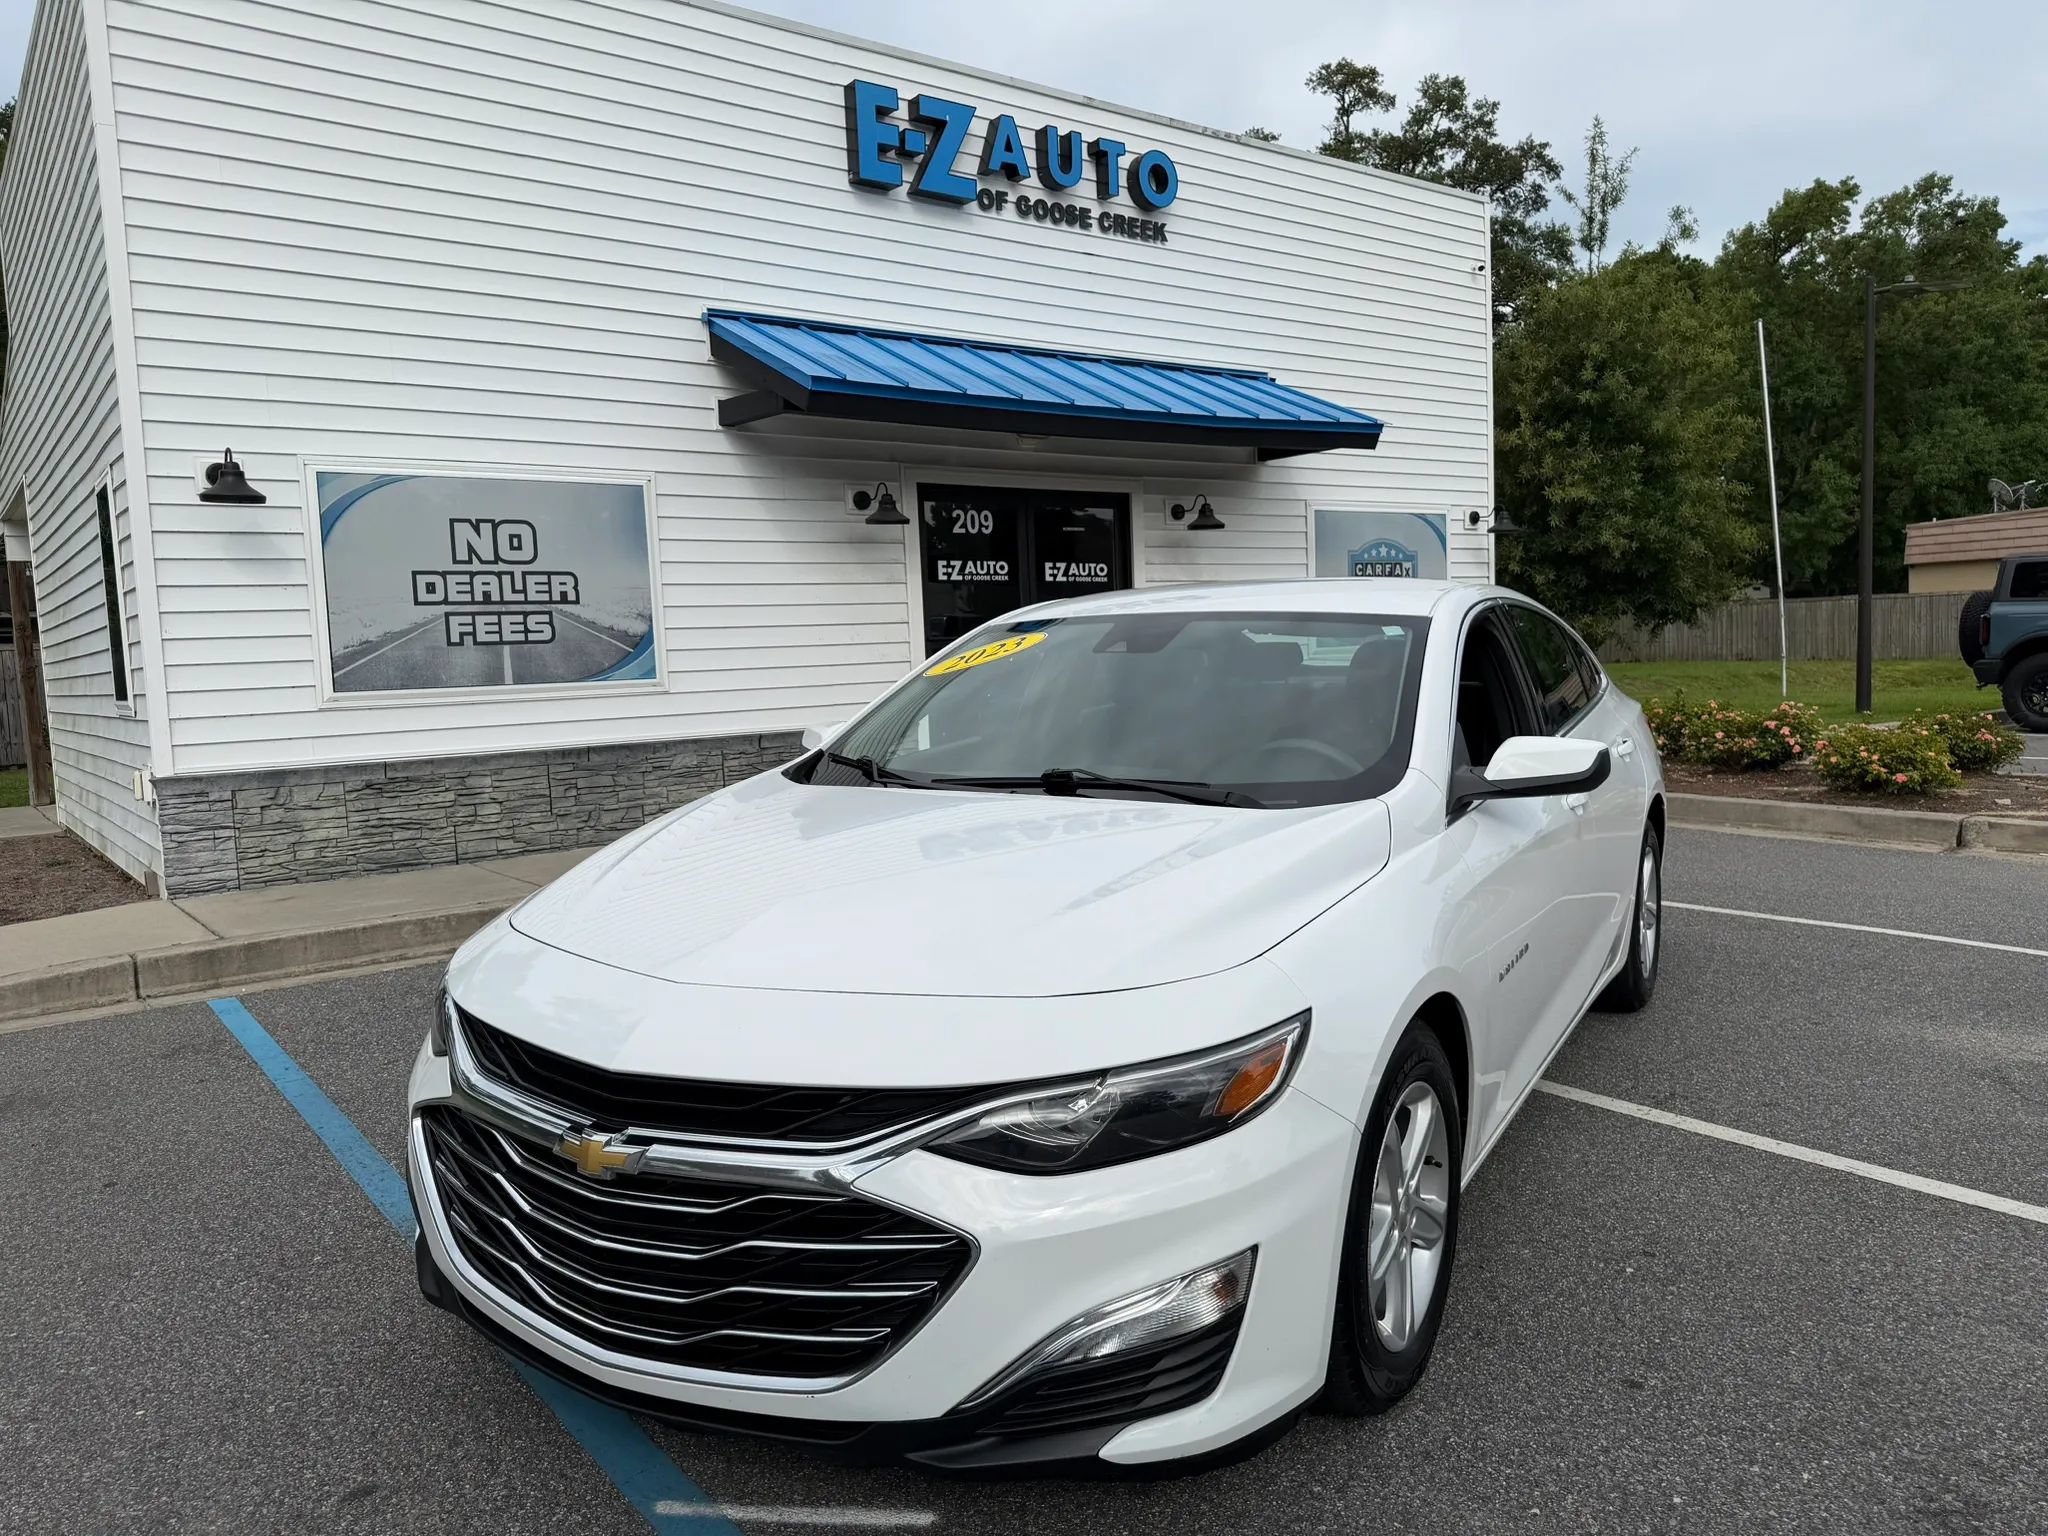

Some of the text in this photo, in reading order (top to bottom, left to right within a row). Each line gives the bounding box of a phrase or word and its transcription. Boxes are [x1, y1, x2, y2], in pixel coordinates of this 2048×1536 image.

[844, 79, 1179, 212] E-Z AUTO
[977, 187, 1169, 243] OF GOOSE CREEK
[952, 509, 994, 534] 209
[449, 518, 538, 565] NO
[937, 560, 1009, 580] E-Z AUTO
[1044, 562, 1108, 581] E-Z AUTO
[1355, 563, 1412, 578] CARFAX
[411, 570, 581, 606] DEALER
[444, 611, 556, 647] FEES
[943, 637, 1027, 672] 2023
